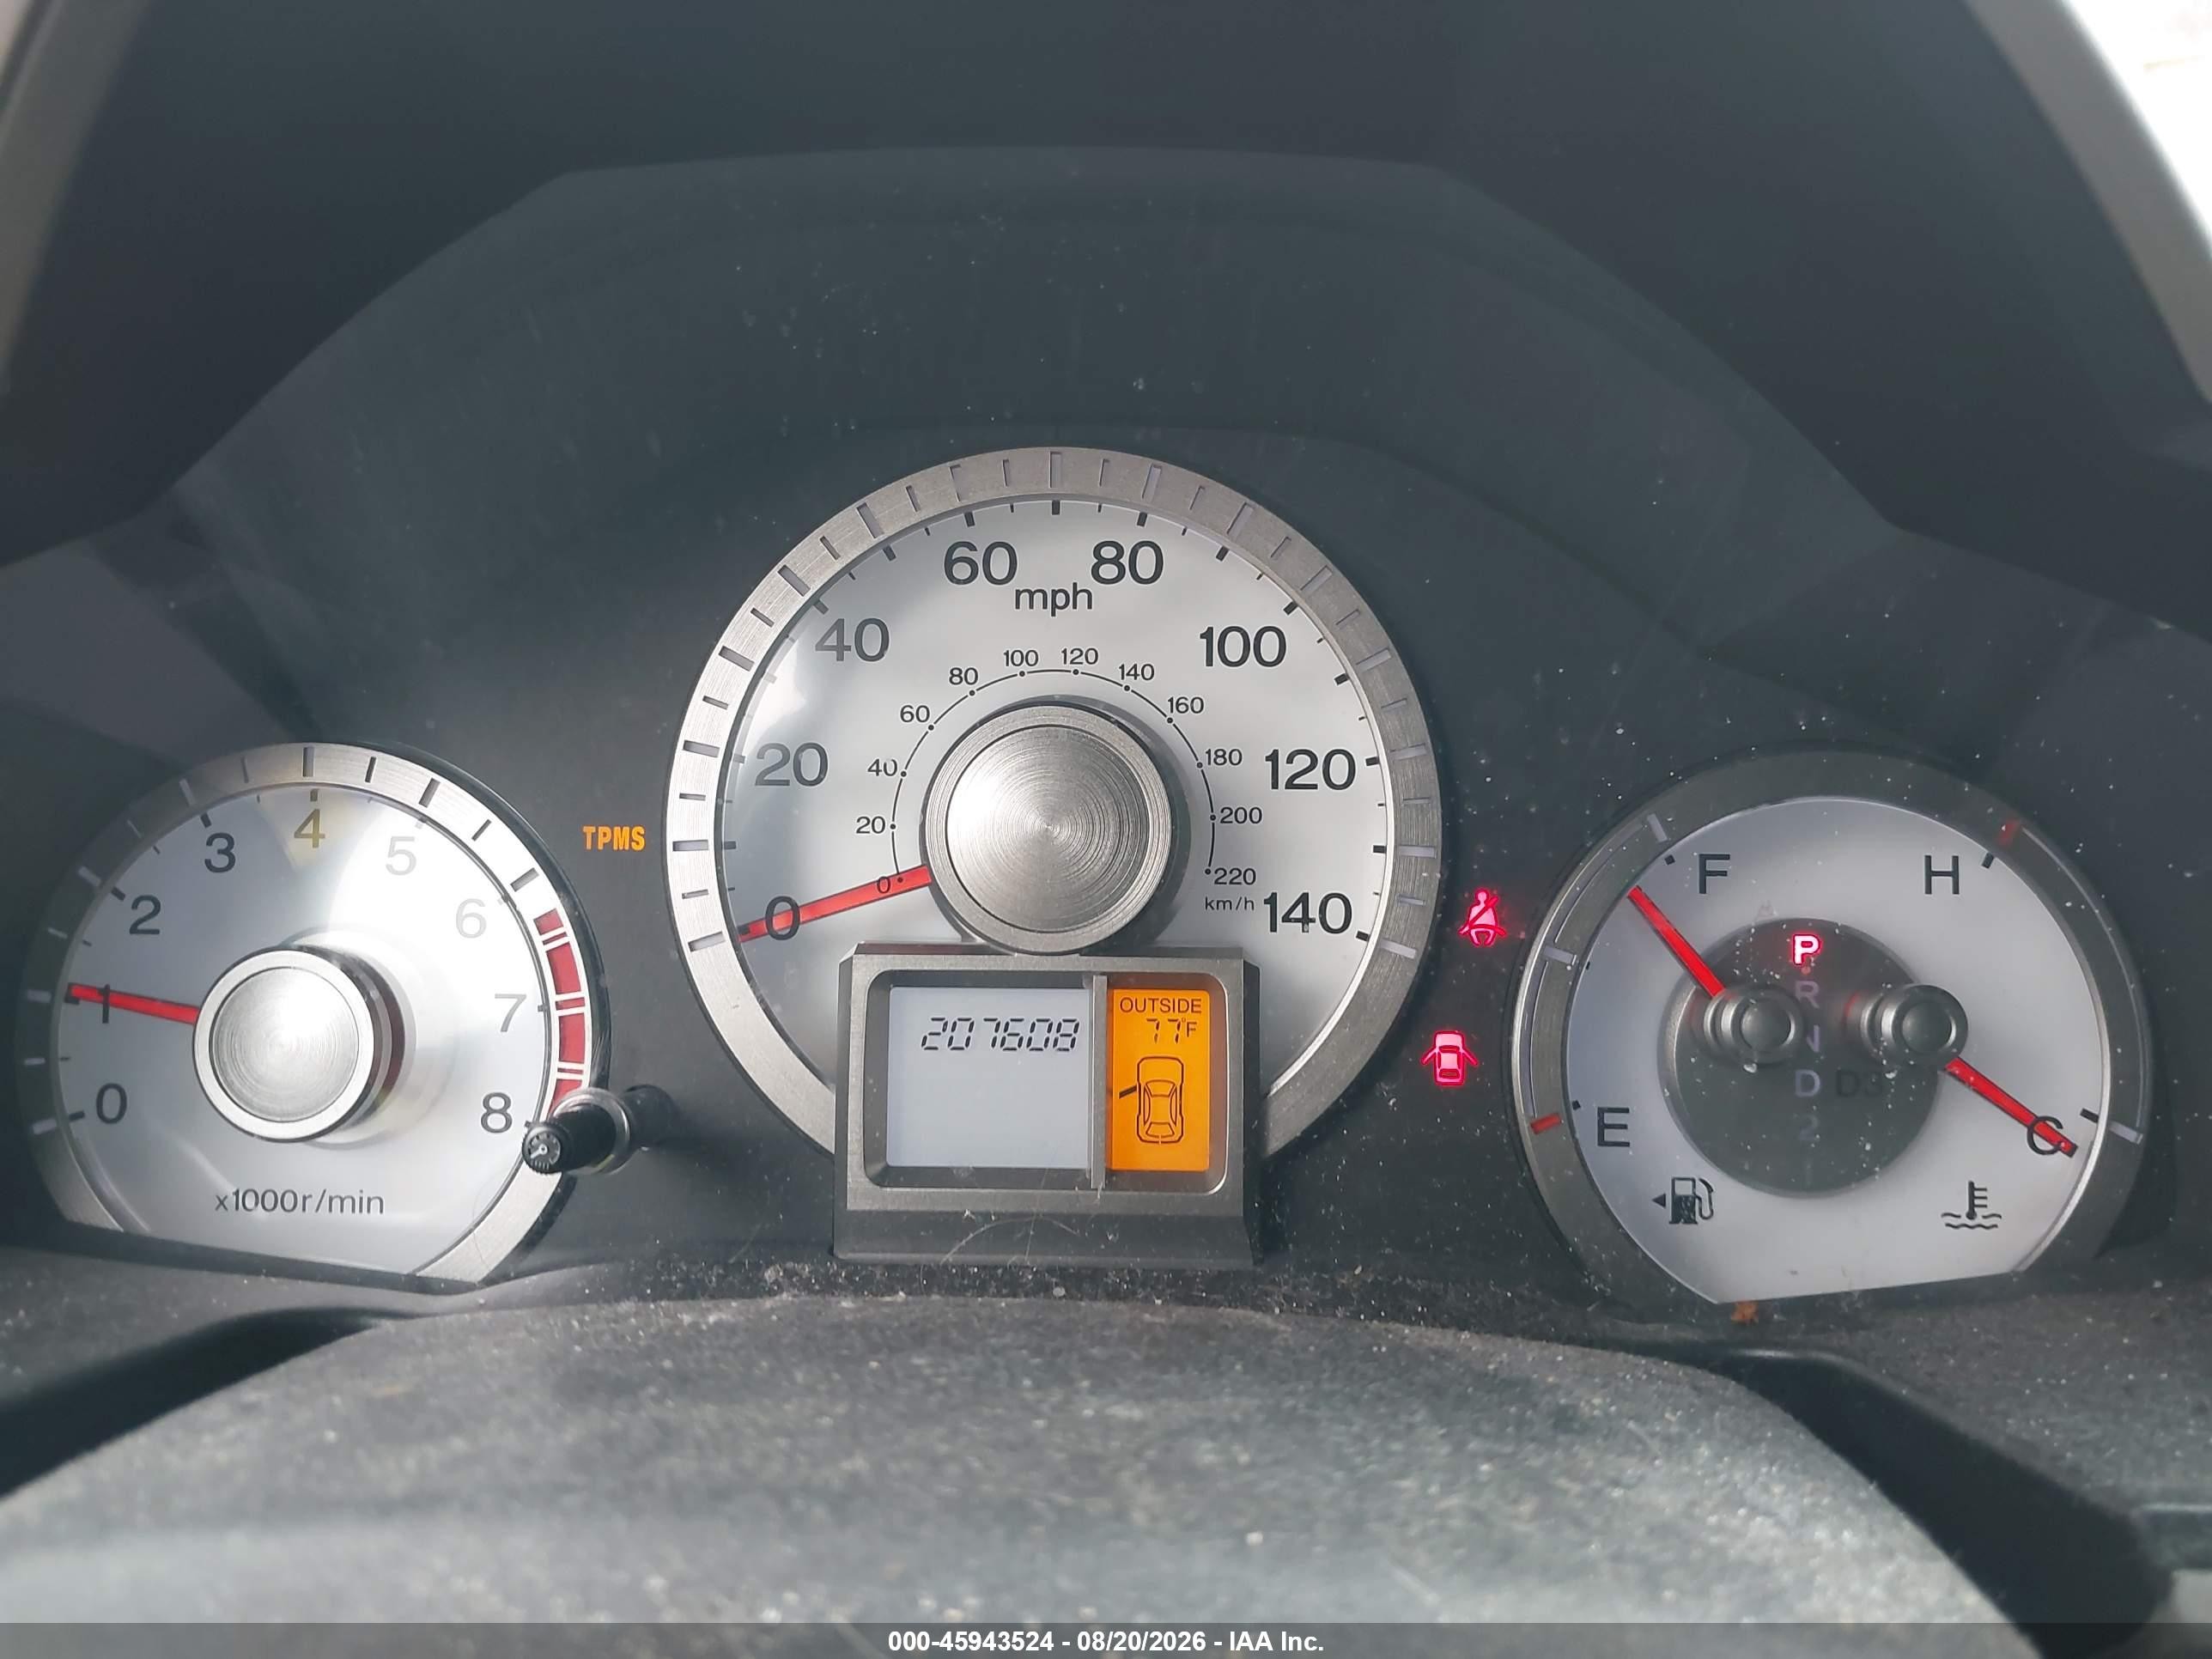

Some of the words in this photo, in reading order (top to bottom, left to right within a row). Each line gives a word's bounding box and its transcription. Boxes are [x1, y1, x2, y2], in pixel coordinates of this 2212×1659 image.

[944, 541, 1018, 586] 60
[1091, 540, 1164, 585] 80
[1014, 582, 1093, 617] mph
[815, 617, 890, 662] 40
[1003, 650, 1039, 666] 100
[1061, 648, 1099, 665] 120
[1199, 625, 1287, 668] 100
[949, 667, 979, 684] 80
[1119, 664, 1155, 681] 140
[900, 705, 930, 722] 60
[1168, 696, 1205, 714] 160
[755, 743, 829, 787] 20
[866, 759, 898, 776] 40
[1206, 749, 1243, 766] 180
[1264, 749, 1357, 791] 120
[294, 810, 325, 848] 4
[856, 817, 886, 834] 20
[1219, 807, 1263, 823] 200
[204, 833, 236, 872] 3
[386, 836, 416, 875] 5
[583, 825, 646, 851] TPMS
[876, 876, 891, 895] 0
[1213, 868, 1257, 885] 220
[1698, 854, 1731, 895] F
[1924, 854, 1960, 896] H
[130, 896, 161, 935] 2
[455, 898, 487, 939] 6
[765, 896, 800, 941] 0
[1205, 896, 1255, 912] km/h
[1262, 891, 1352, 934] 140
[1792, 933, 1821, 966] P
[100, 985, 111, 1024] 1
[494, 994, 526, 1033] 7
[1119, 996, 1202, 1015] OUTSIDE
[921, 1017, 1080, 1052] 207608
[1795, 1069, 1821, 1097] D
[95, 1083, 128, 1125] 0
[481, 1093, 513, 1134] 8
[1597, 1107, 1630, 1147] E
[2027, 1116, 2064, 1156] C
